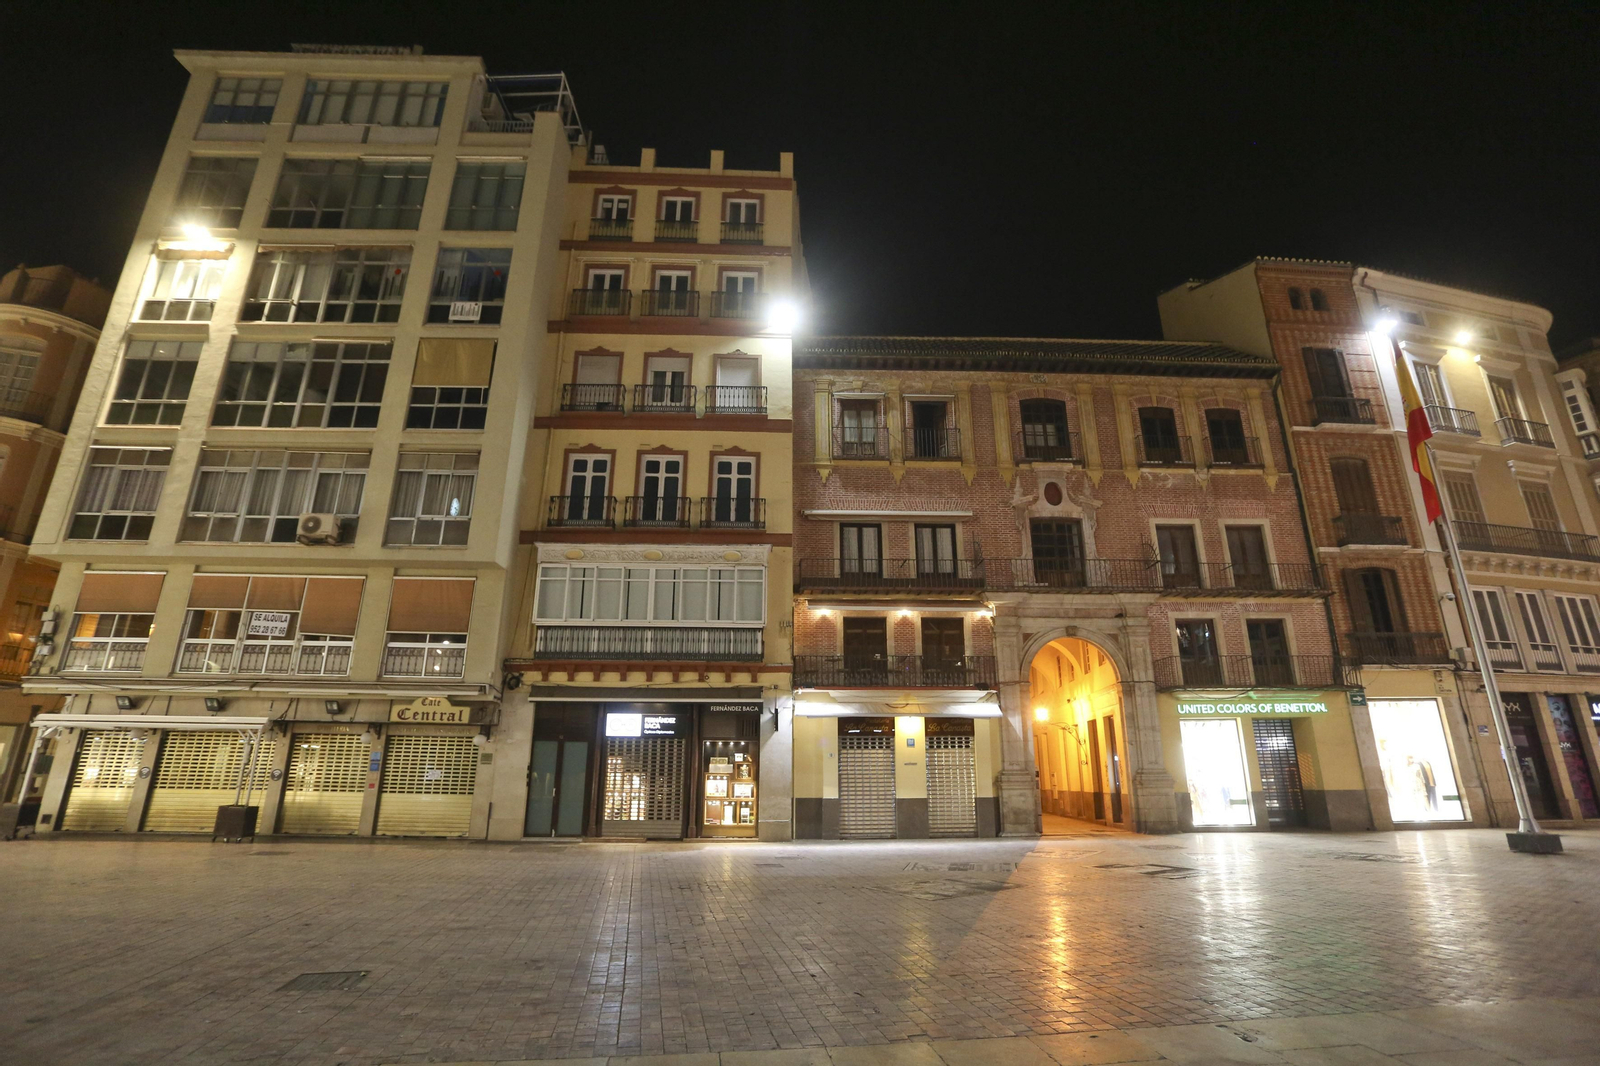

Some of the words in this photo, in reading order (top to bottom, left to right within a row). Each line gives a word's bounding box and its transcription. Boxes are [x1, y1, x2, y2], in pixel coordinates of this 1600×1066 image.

[254, 613, 263, 621] SE
[263, 614, 288, 623] ALQUILA
[710, 704, 742, 712] FERNÁNDEZ
[1178, 704, 1215, 714] UNITED
[1217, 703, 1257, 714] COLORS
[1258, 703, 1273, 713] OF
[397, 708, 463, 721] Central
[928, 722, 941, 732] La
[941, 722, 972, 732] Canasta
